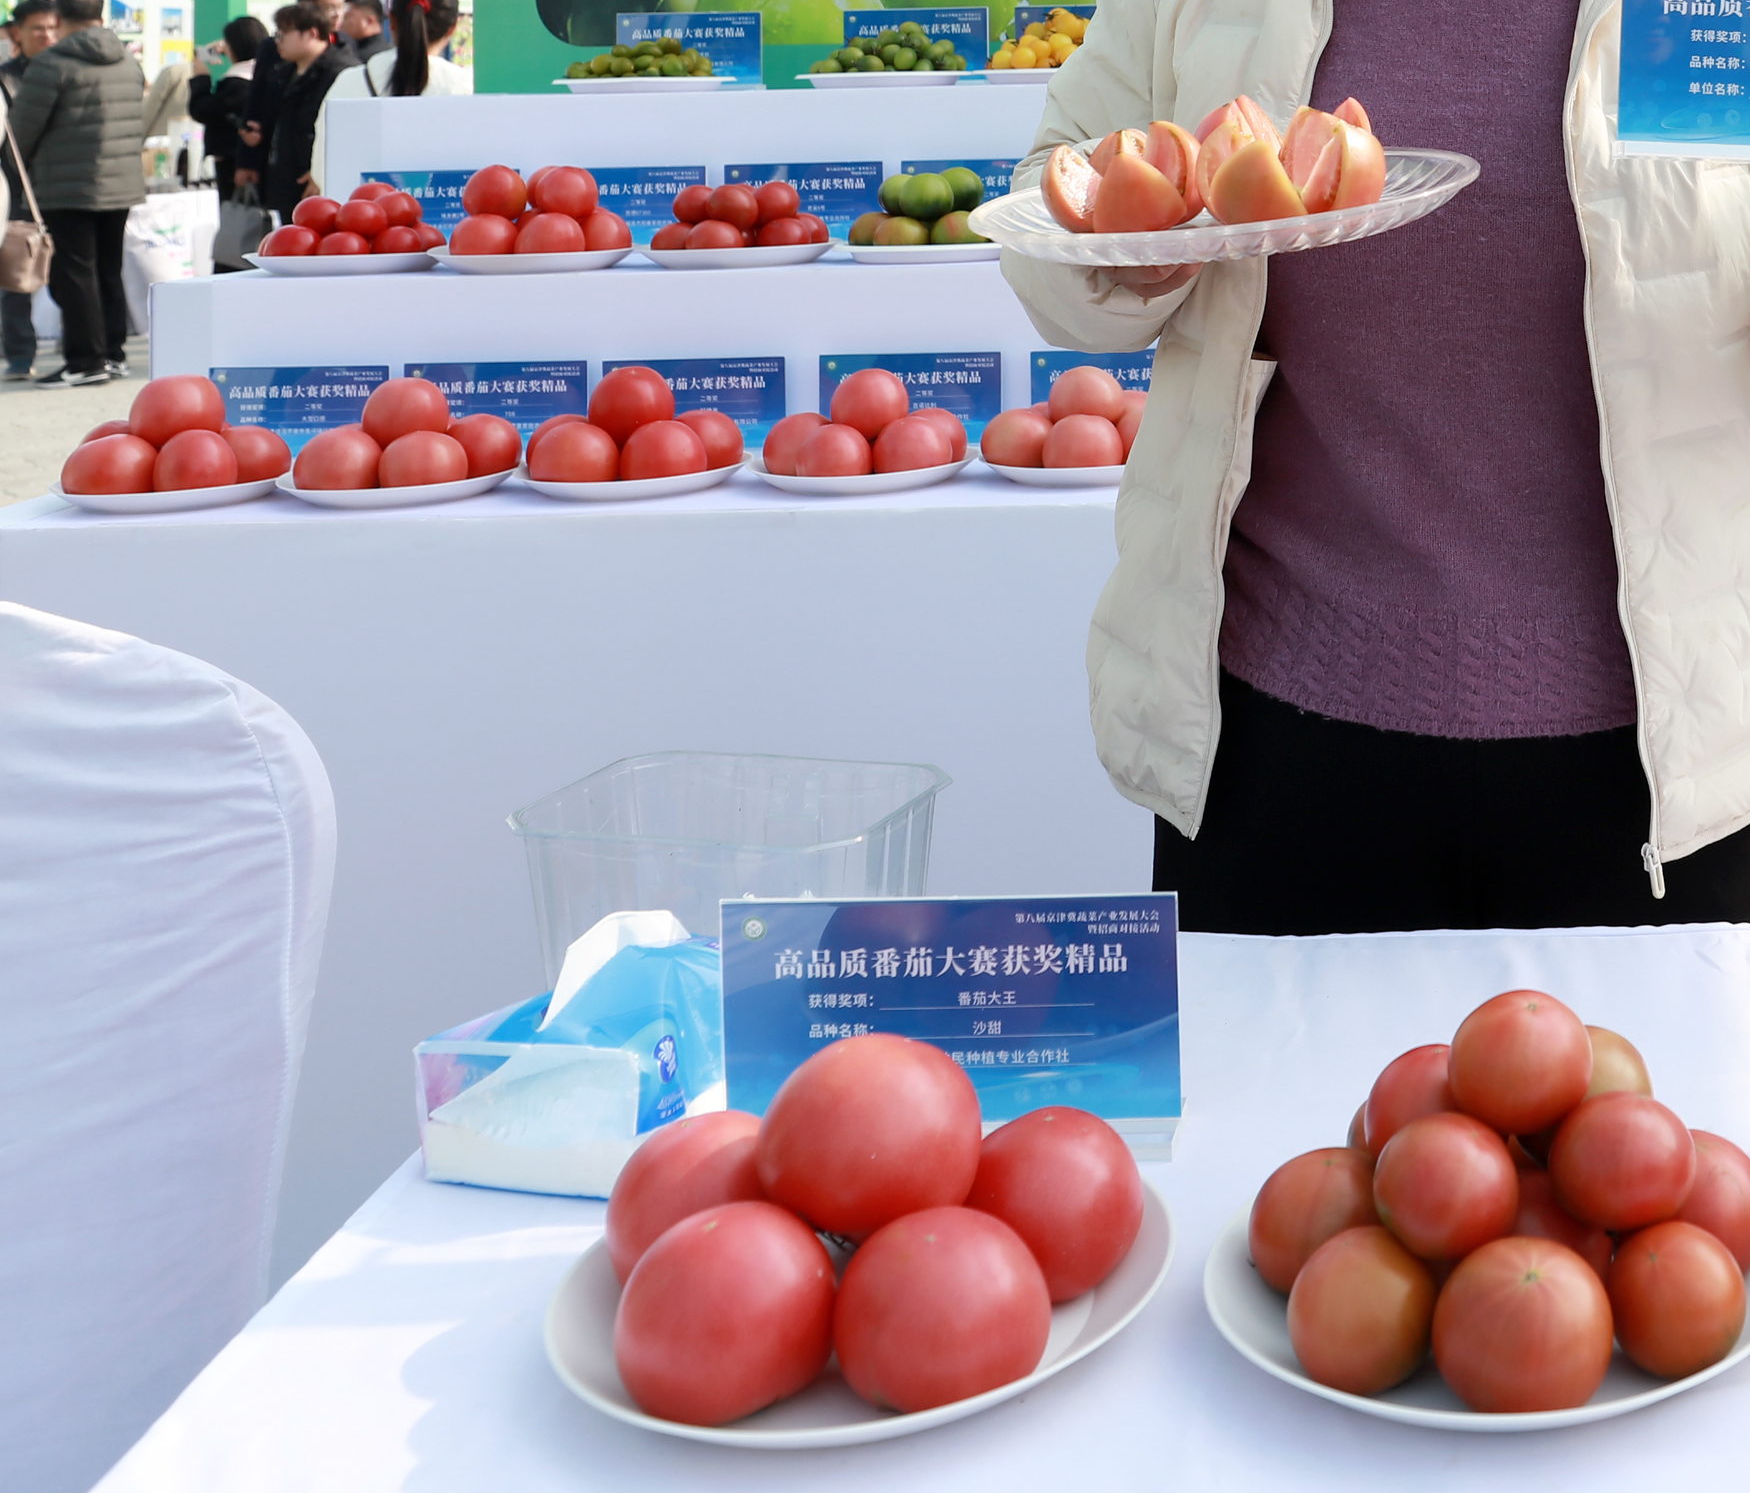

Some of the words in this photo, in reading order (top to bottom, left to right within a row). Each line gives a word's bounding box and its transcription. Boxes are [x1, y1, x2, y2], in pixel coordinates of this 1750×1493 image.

[1690, 29, 1747, 44] 获得奖项：
[1689, 55, 1746, 70] 品种名称：
[1688, 81, 1746, 97] 单位名称：
[229, 385, 370, 399] 高品质番茄大赛获奖精品
[1015, 910, 1159, 925] 第八届京津冀蔬菜产业发展大会
[774, 943, 1128, 980] 高品质番茄大赛获奖精品
[808, 993, 874, 1008] 获得奖项：
[957, 992, 1017, 1006] 番茄大王
[809, 1023, 874, 1039] 品种名称：
[972, 1020, 1002, 1036] 沙甜
[944, 1049, 1070, 1066] 民种植专业合作社
